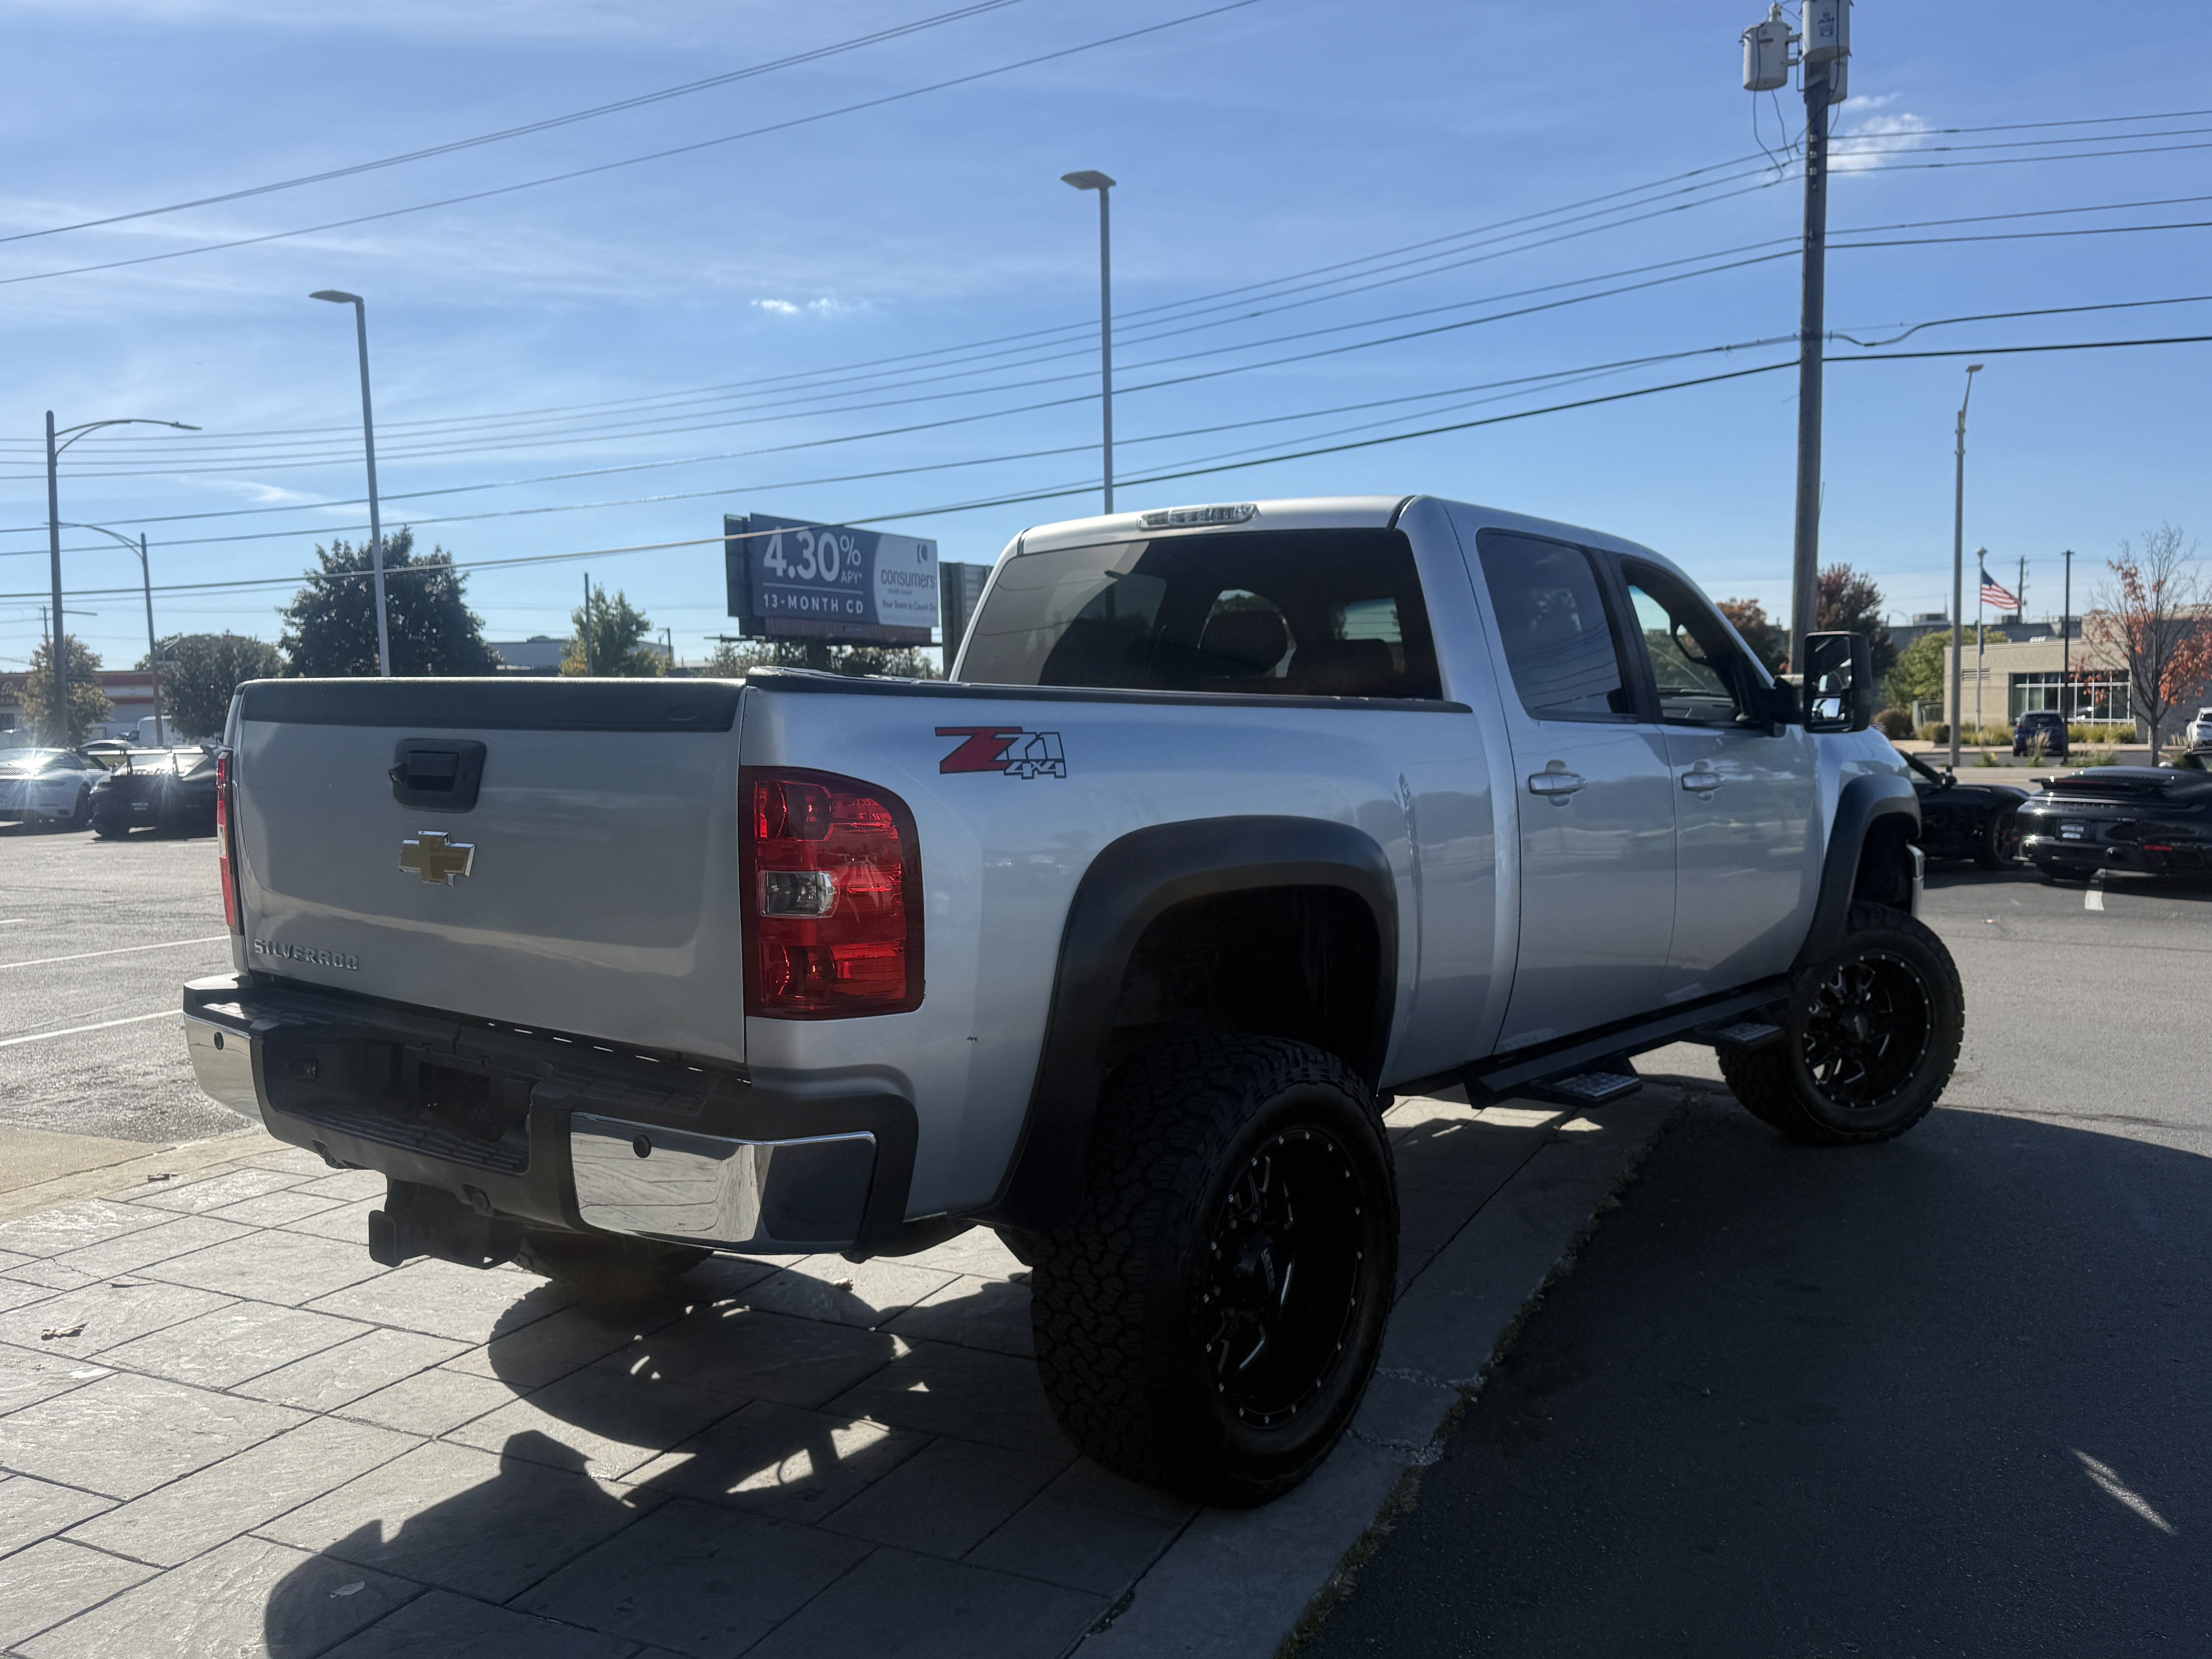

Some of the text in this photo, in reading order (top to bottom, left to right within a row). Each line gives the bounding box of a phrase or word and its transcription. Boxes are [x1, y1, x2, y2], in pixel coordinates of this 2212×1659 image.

[764, 526, 861, 582] 4.30%
[881, 569, 936, 590] consumers
[846, 599, 864, 615] CD
[935, 726, 1065, 775] Z71
[254, 939, 359, 971] SILVERADO
